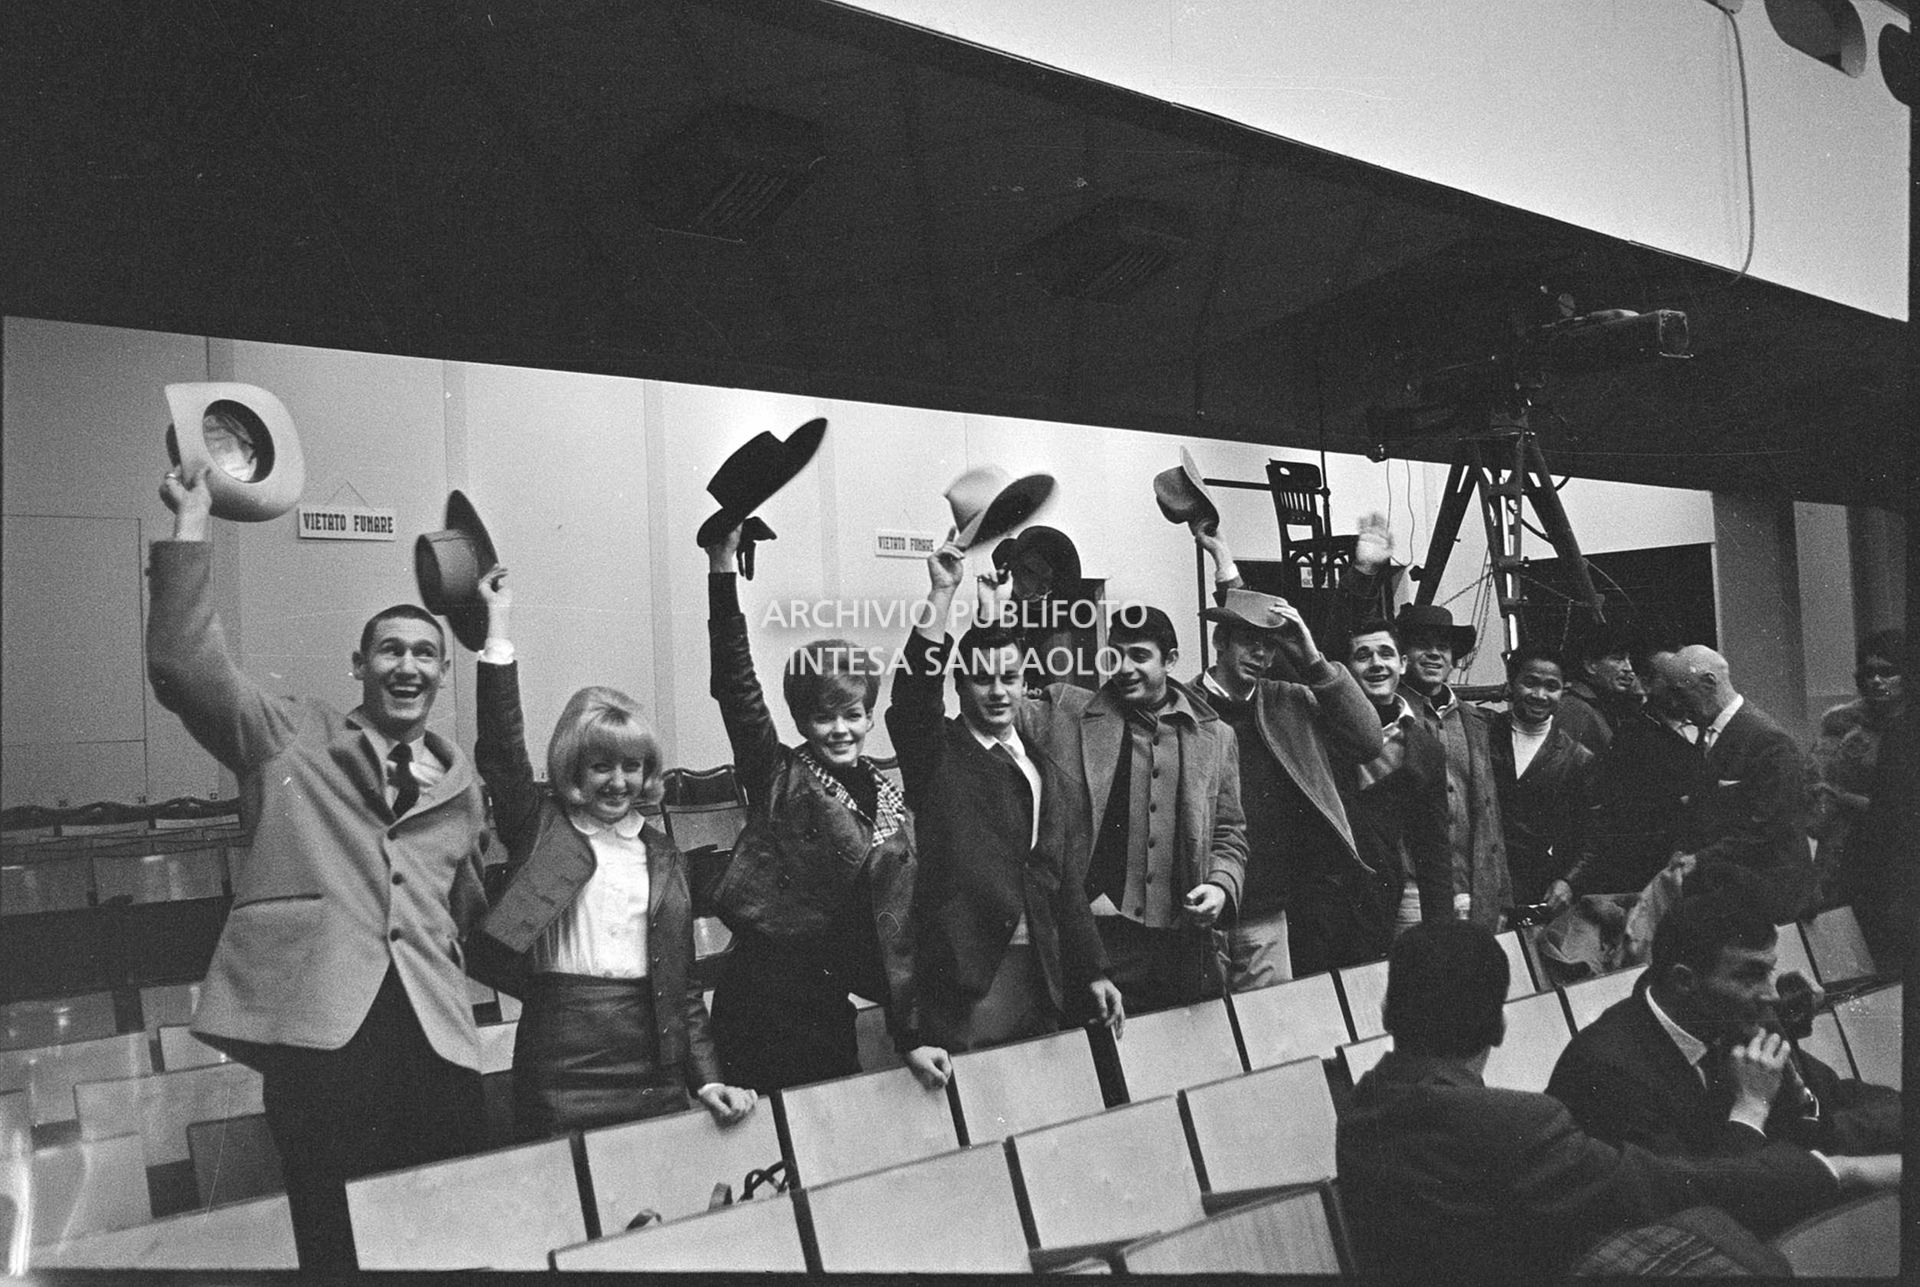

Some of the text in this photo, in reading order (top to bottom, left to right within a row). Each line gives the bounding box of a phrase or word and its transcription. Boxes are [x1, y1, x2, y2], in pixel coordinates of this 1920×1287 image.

[303, 513, 393, 533] VIETATO FUMARE
[878, 536, 905, 550] VIETATO
